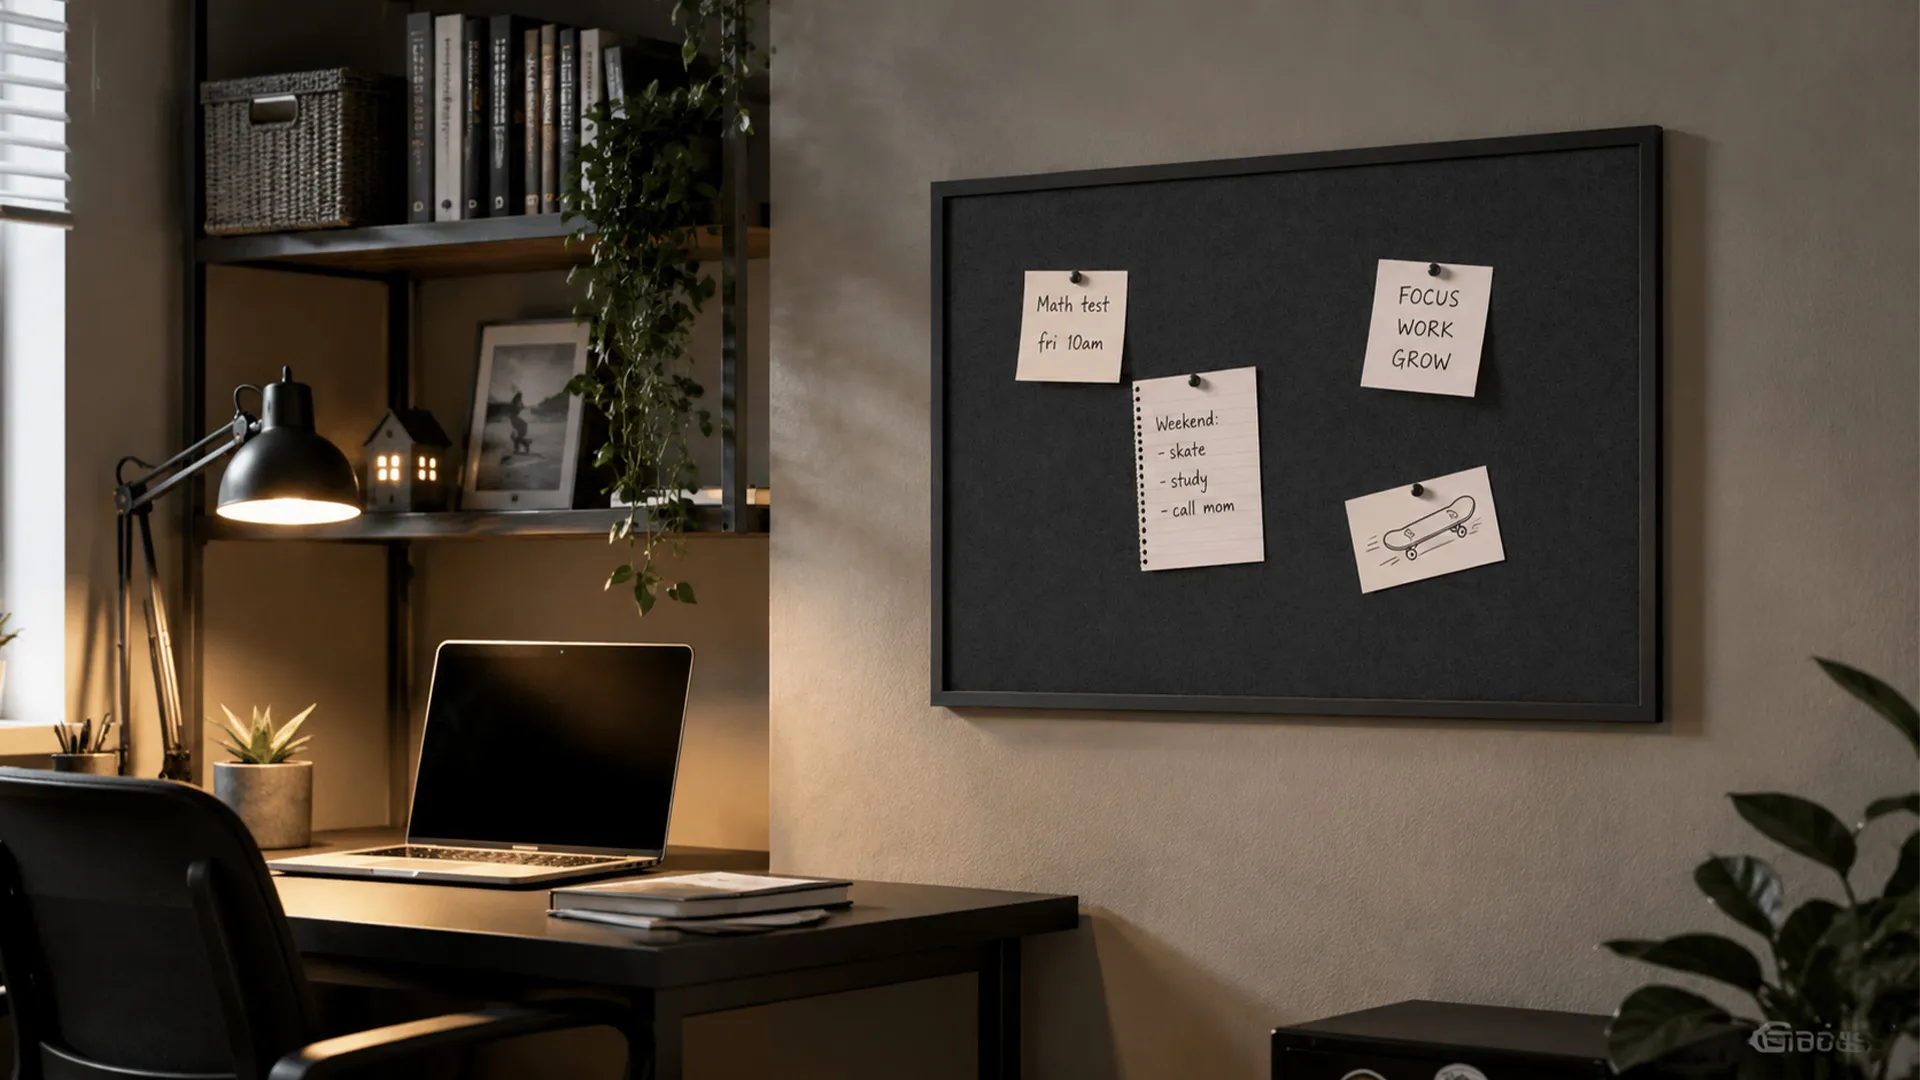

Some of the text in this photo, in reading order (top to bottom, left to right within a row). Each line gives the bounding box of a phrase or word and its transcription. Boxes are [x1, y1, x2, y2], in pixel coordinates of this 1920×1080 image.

[1037, 295, 1110, 312] Math test
[1399, 286, 1459, 307] FOCUS
[1398, 318, 1453, 338] WORK
[1038, 331, 1103, 353] fri 10am
[1392, 349, 1451, 370] GROW
[1156, 410, 1218, 431] Weekend:
[1170, 441, 1206, 459] skate
[1171, 469, 1207, 493] study
[1173, 500, 1195, 517] call
[1204, 502, 1235, 514] mom
